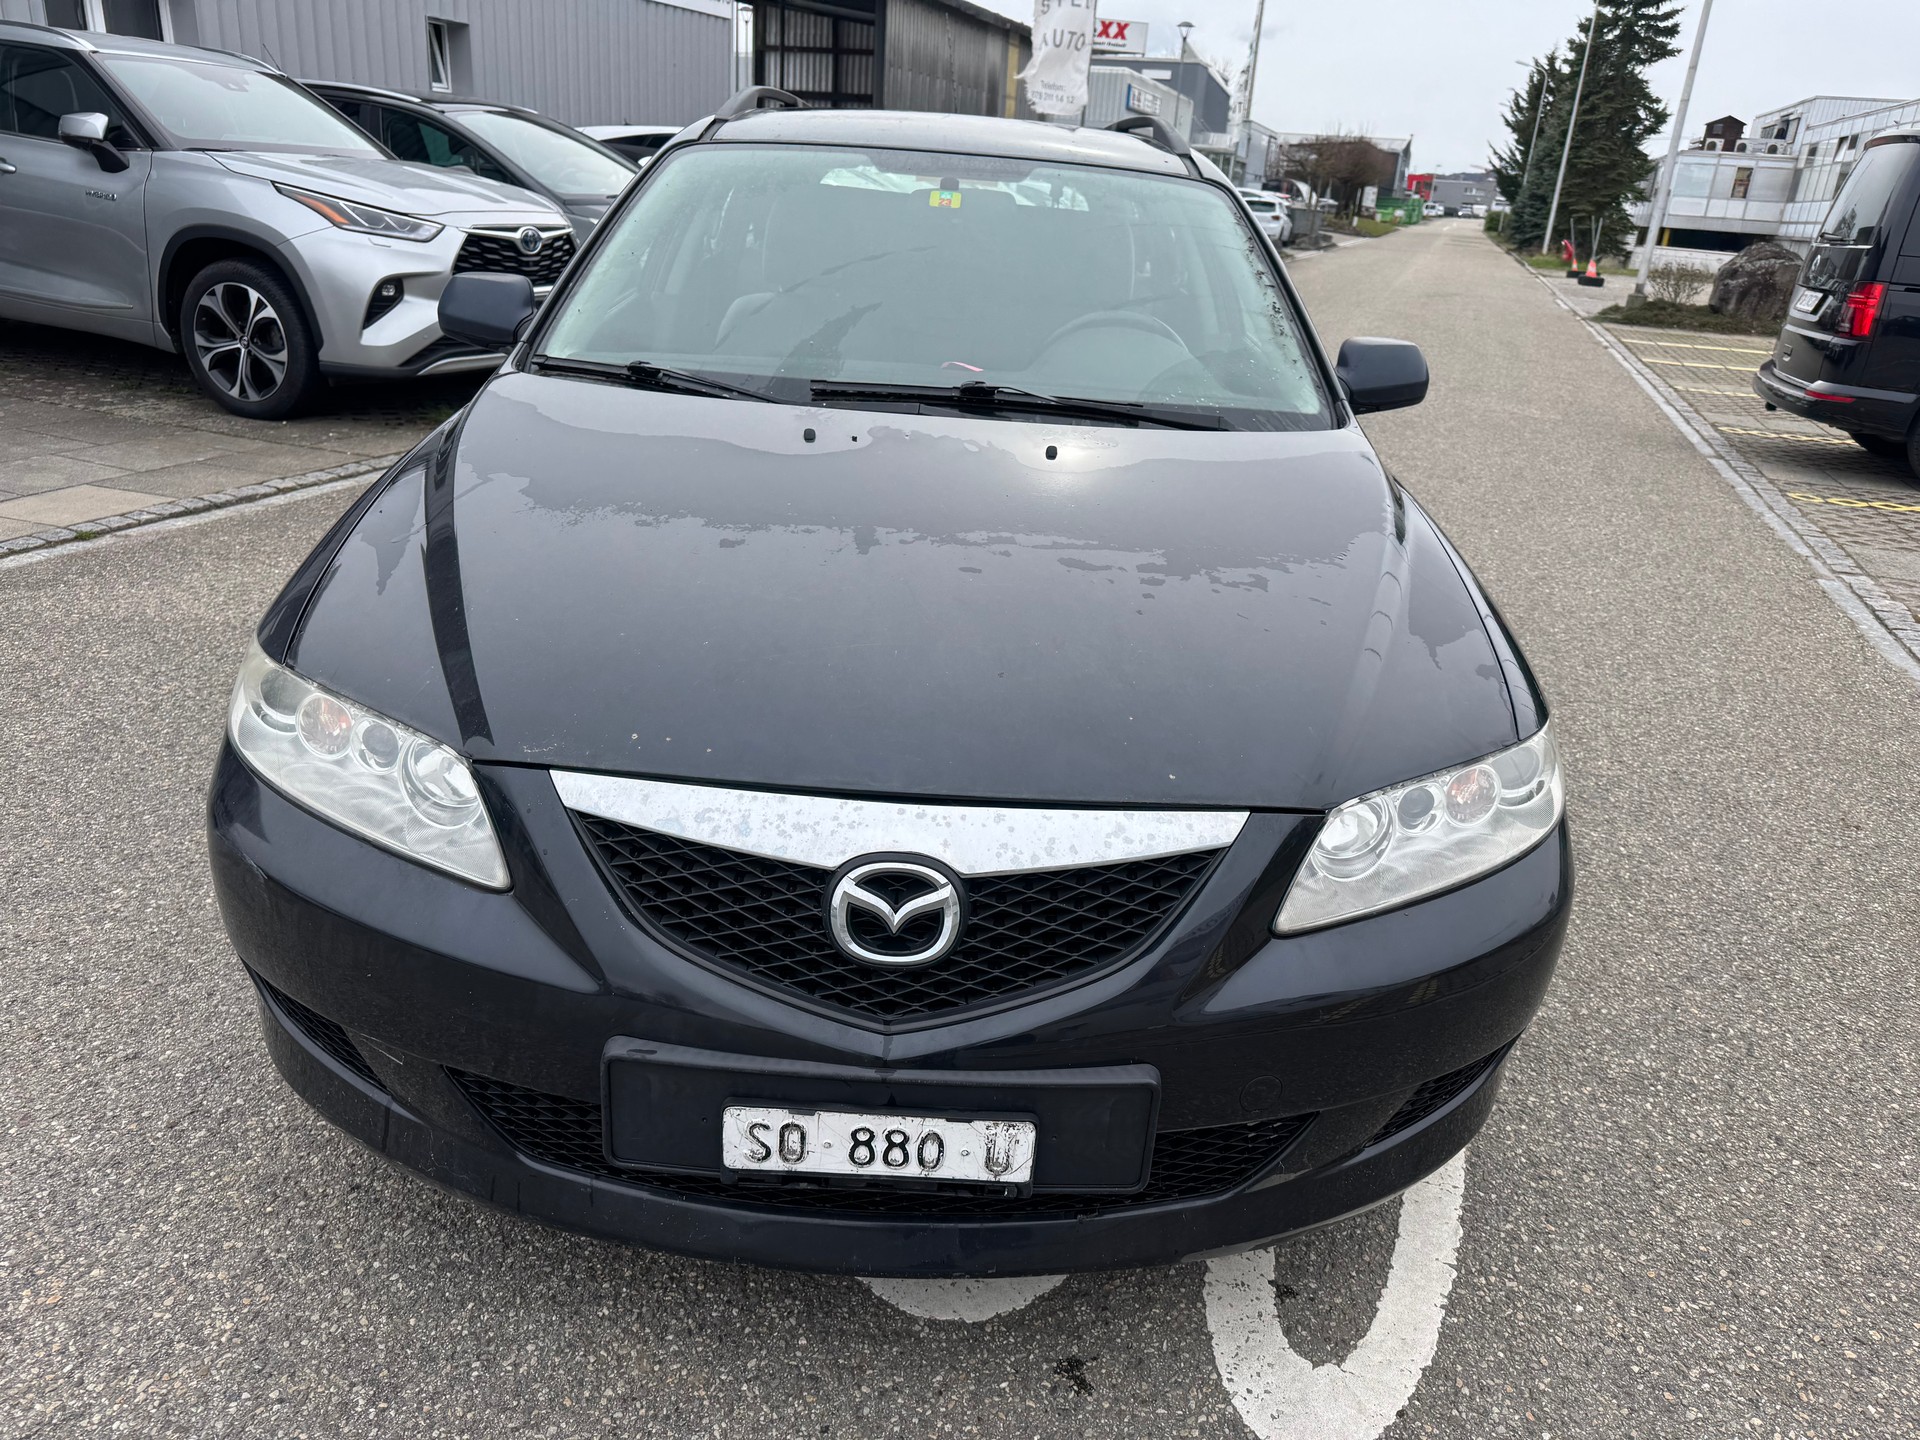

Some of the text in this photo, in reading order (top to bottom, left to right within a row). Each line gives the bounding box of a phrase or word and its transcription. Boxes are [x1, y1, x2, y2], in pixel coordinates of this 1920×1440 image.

[747, 1121, 1014, 1177] SO 880 U
